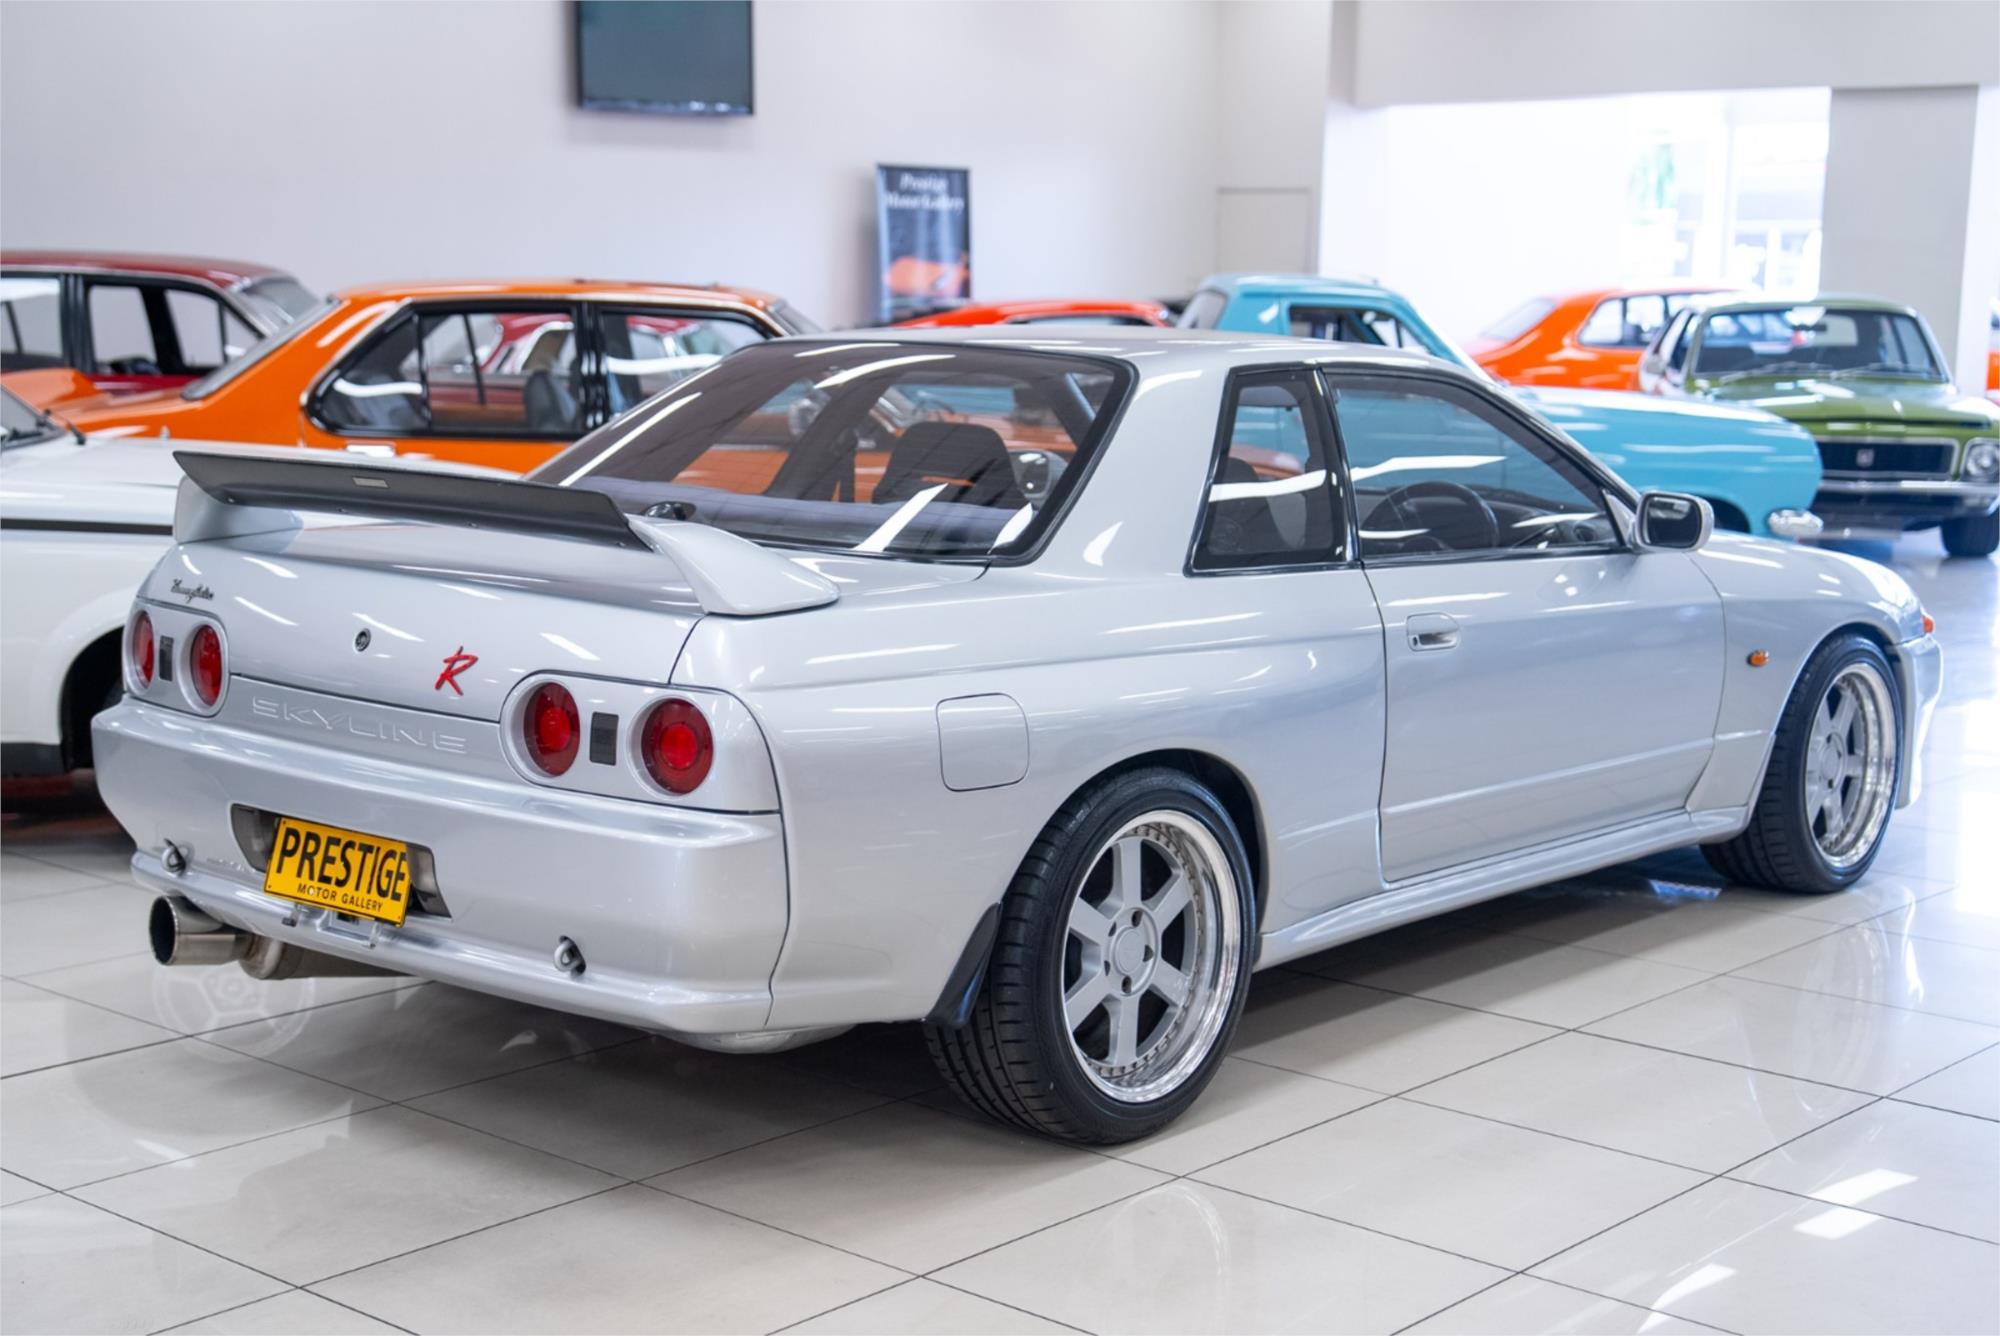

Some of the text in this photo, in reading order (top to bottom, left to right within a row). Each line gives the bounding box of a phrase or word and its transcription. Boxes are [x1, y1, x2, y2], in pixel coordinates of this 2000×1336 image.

[435, 646, 479, 696] R
[252, 696, 467, 754] SKYLINE
[276, 827, 407, 902] PRESTIGE
[297, 883, 383, 912] MOTOR GALLERY
